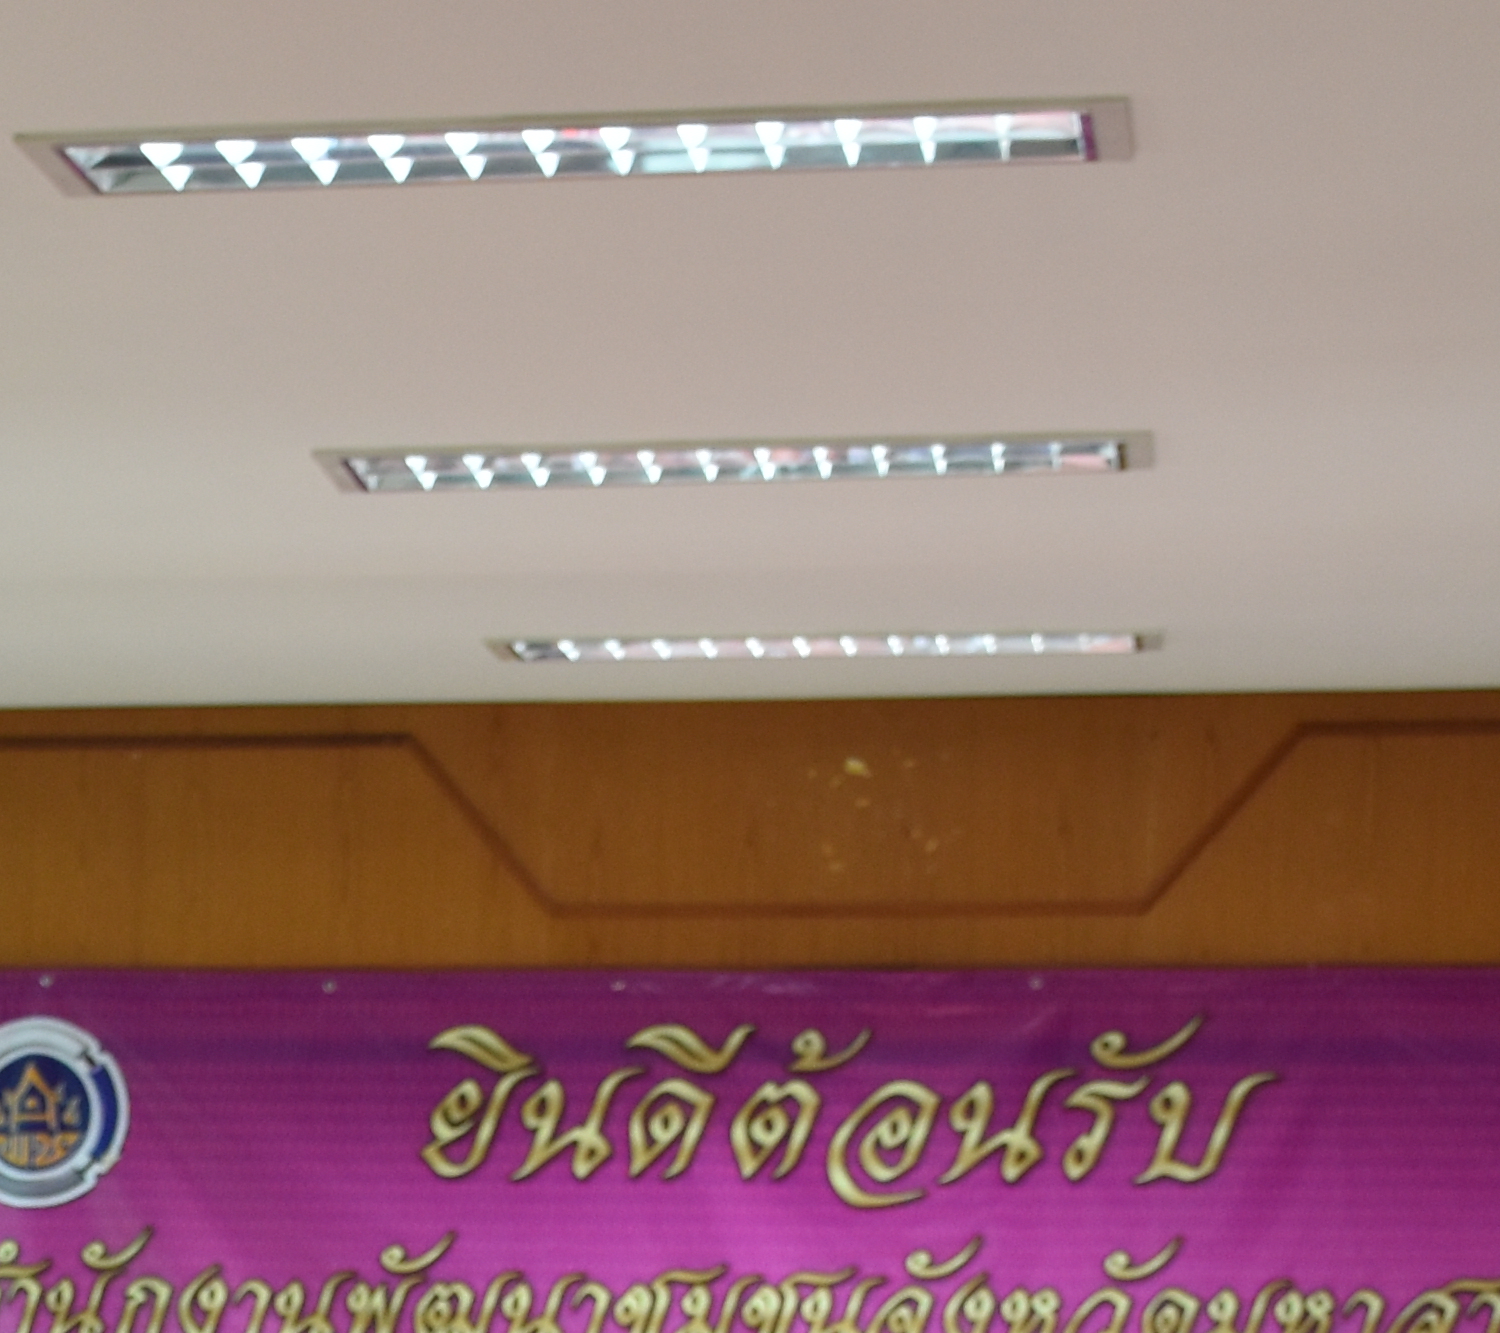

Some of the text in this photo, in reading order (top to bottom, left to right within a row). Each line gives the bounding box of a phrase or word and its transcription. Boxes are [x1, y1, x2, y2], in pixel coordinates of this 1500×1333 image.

[418, 1013, 1278, 1208] ยินดีต้อนรับ
